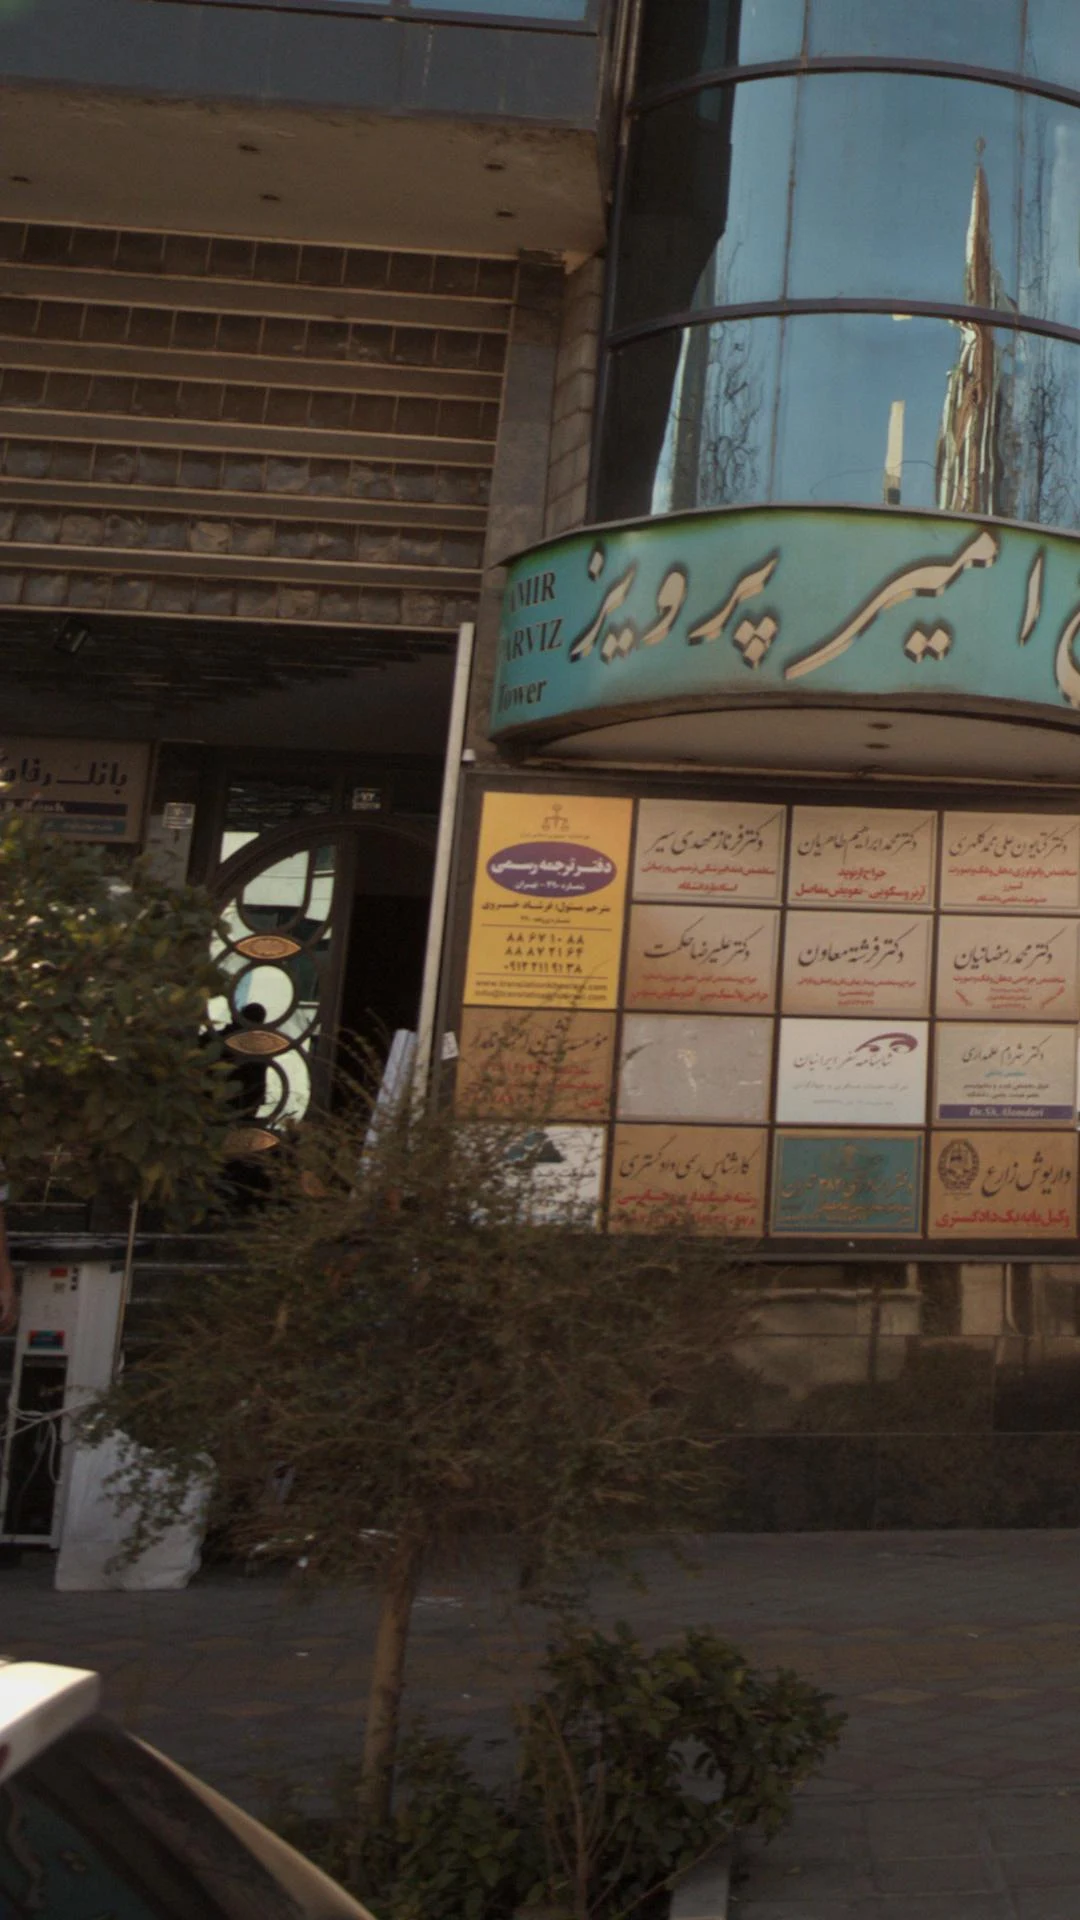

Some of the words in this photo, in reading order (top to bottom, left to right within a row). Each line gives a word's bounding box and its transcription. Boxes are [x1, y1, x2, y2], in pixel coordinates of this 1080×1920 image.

[568, 539, 781, 669] پرویز
[784, 527, 1044, 680] امیر
[56, 760, 129, 796] بانک
[731, 810, 781, 857] دکتر
[891, 815, 932, 856] دکتر
[1043, 822, 1080, 859] دکتر
[491, 859, 539, 876] رسمی
[539, 857, 576, 877] ترجمه
[573, 857, 612, 877] دفتر
[720, 924, 765, 966] دکتر
[869, 922, 920, 971] دکتر
[1022, 925, 1068, 971] دکتر
[1022, 1034, 1053, 1066] دکتر
[1015, 1150, 1072, 1195] داریوش
